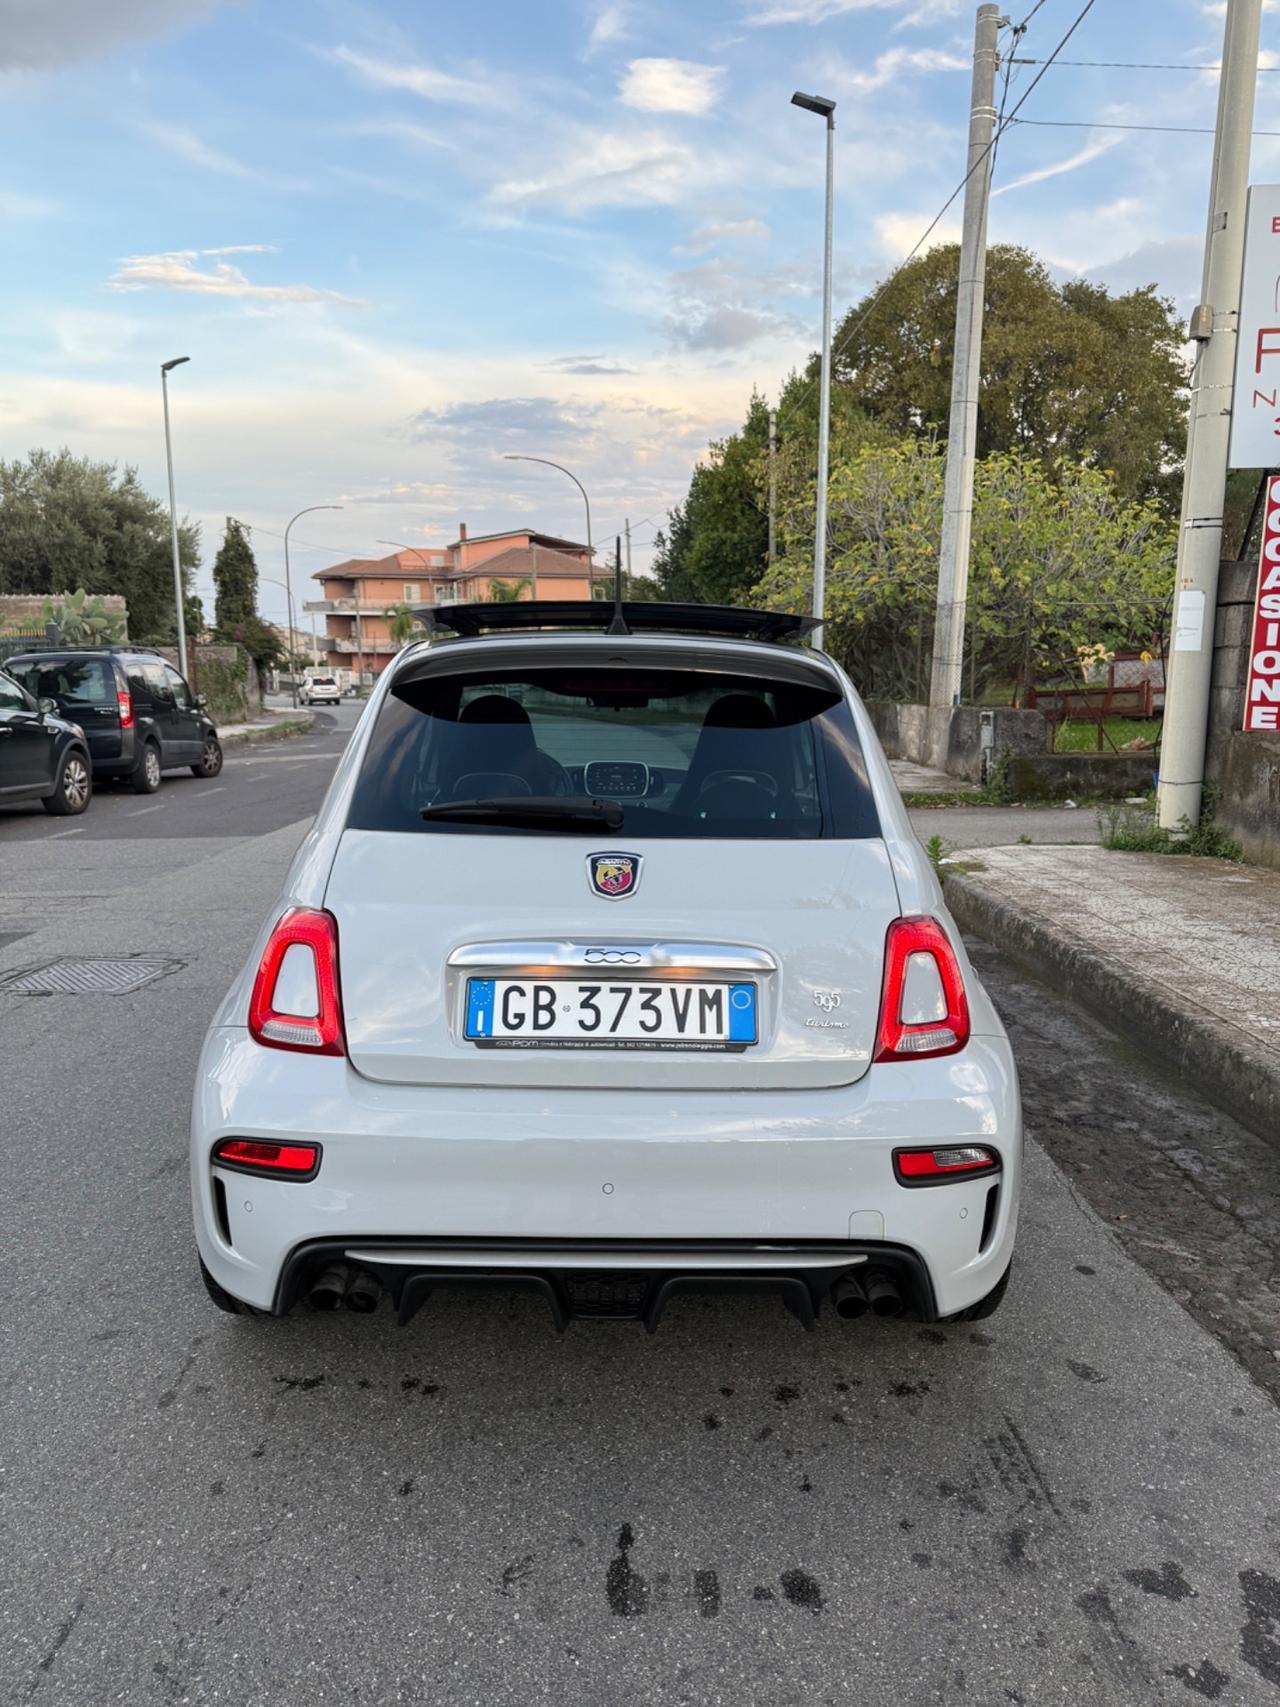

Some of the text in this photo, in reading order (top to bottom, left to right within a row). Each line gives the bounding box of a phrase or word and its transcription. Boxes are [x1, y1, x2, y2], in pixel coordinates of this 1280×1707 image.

[584, 948, 642, 965] 500
[501, 984, 724, 1035] GB 373VM
[813, 989, 841, 1012] 595
